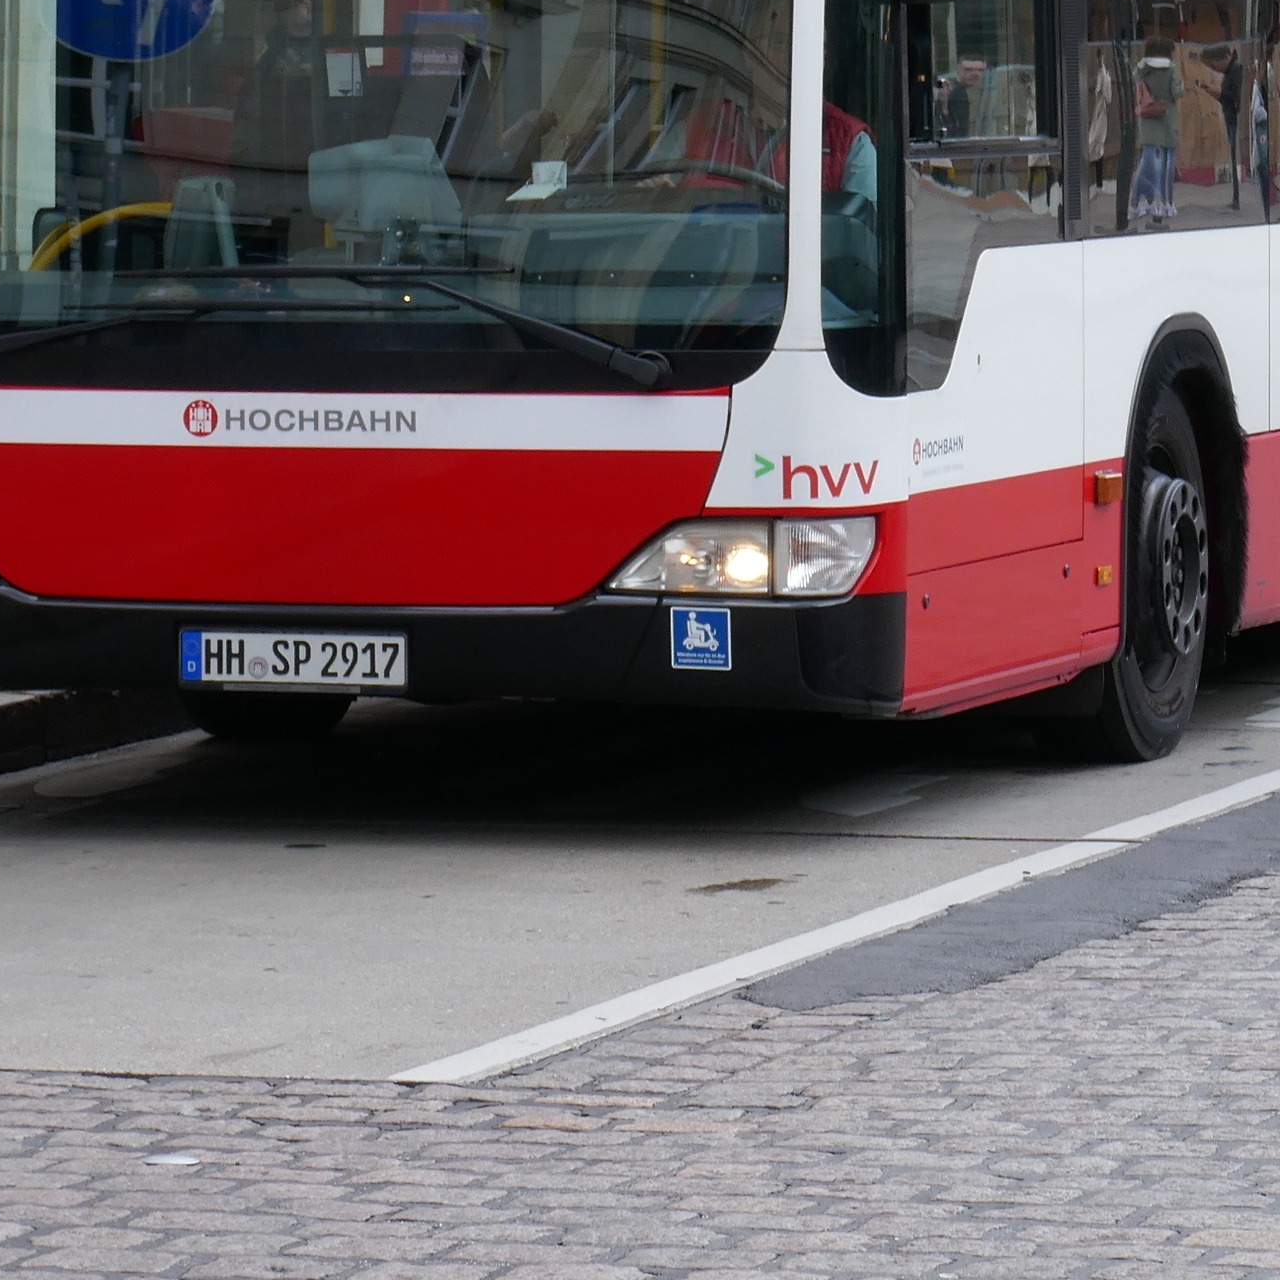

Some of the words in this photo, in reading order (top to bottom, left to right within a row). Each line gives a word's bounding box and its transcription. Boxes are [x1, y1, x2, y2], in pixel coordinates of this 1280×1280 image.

[225, 405, 416, 433] HOCHBAHN
[922, 435, 963, 459] HOCHBAHN
[782, 455, 879, 499] hvv
[188, 661, 195, 672] D
[205, 639, 245, 675] HH
[271, 640, 311, 675] SP
[321, 642, 400, 679] 2917
